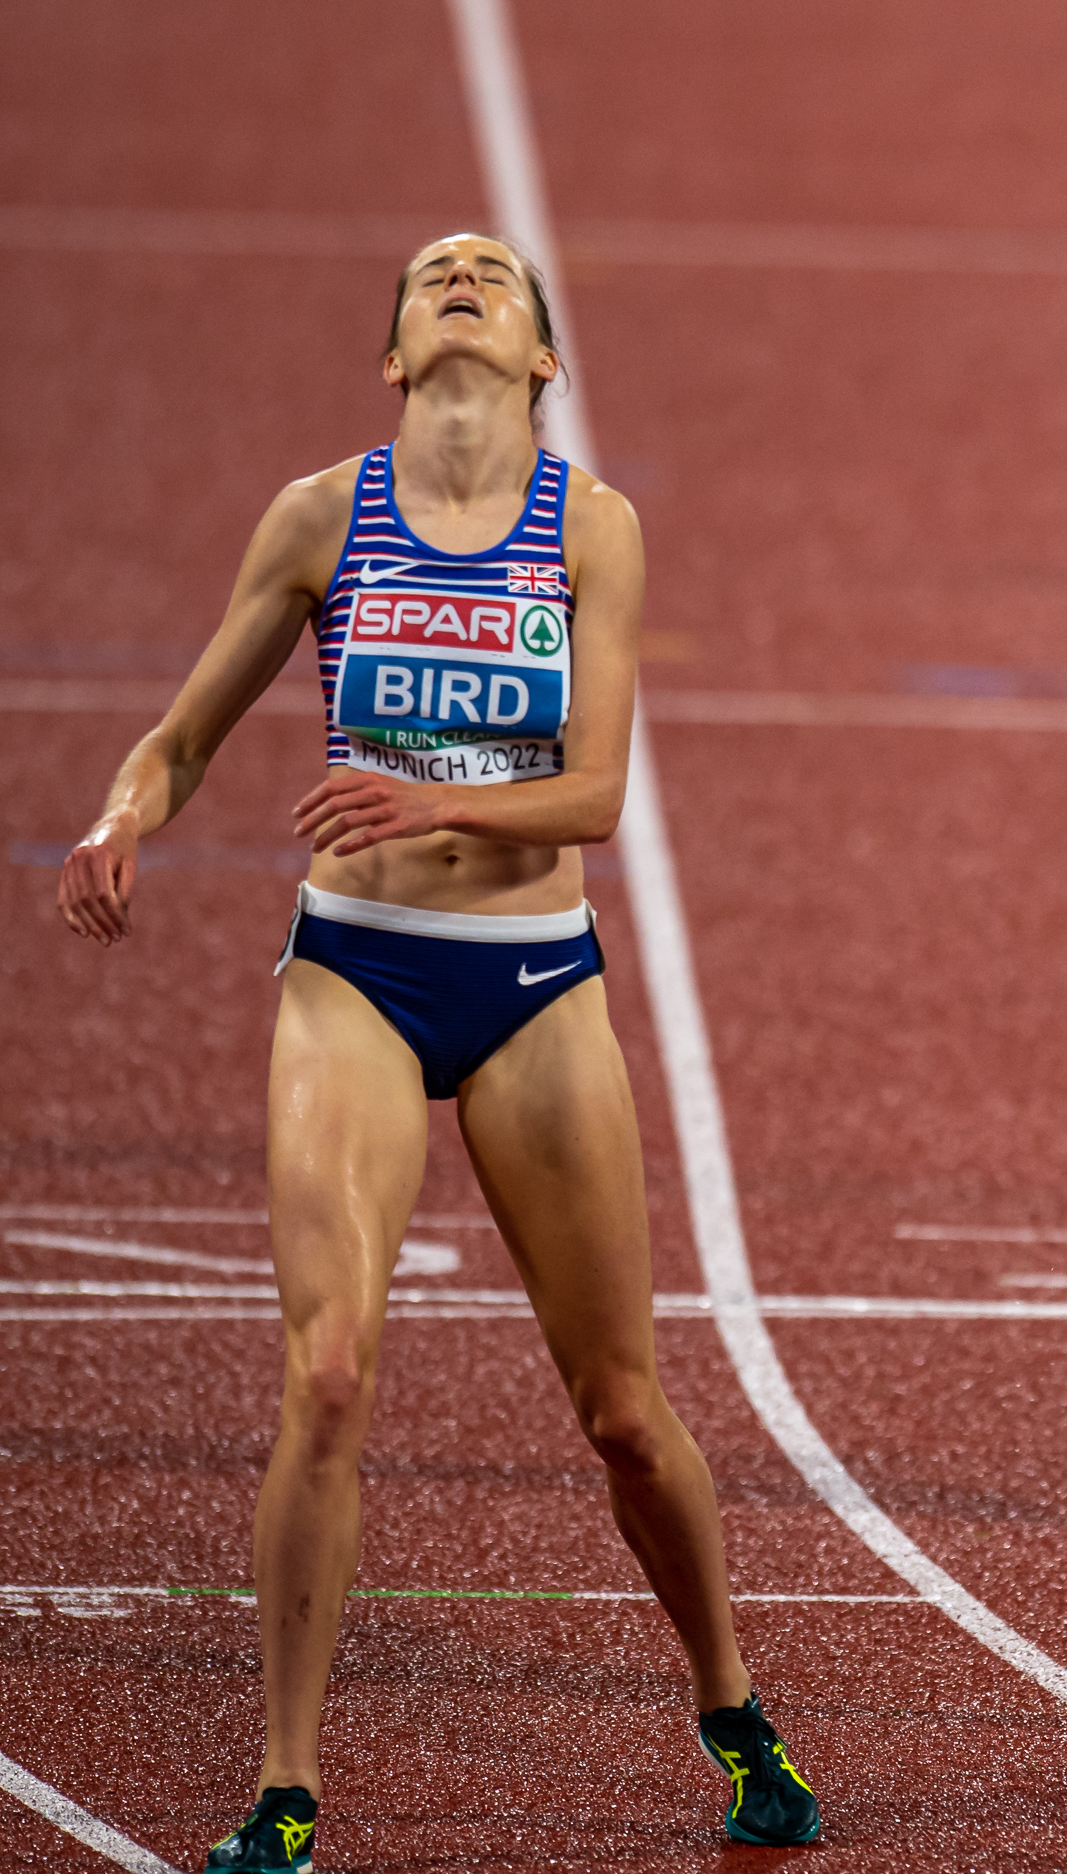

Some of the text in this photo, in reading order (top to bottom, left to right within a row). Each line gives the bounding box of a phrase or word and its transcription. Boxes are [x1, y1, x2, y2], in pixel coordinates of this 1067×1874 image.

[357, 600, 511, 645] SPAR
[373, 664, 530, 726] BIRD
[396, 731, 437, 748] RUN
[361, 741, 541, 782] MUNICH 2022
